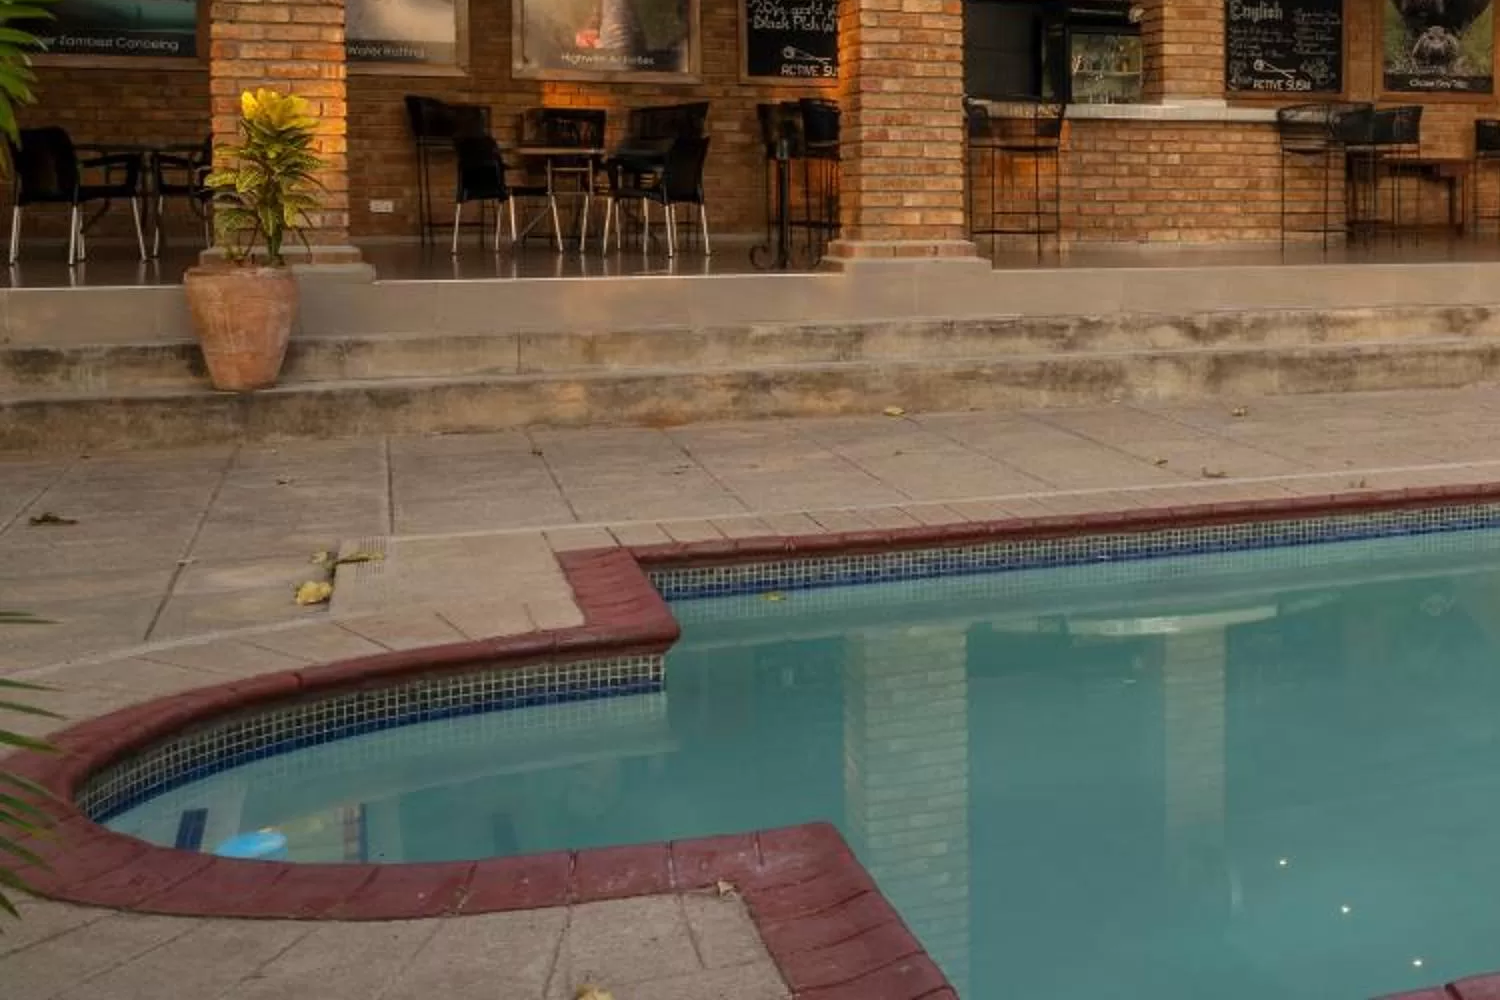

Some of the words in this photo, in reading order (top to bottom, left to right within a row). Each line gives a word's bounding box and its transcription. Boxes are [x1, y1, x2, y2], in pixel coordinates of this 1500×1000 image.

[115, 36, 179, 51] Canoeing
[781, 63, 820, 76] ACTIVE
[1253, 79, 1284, 90] ACTIVE
